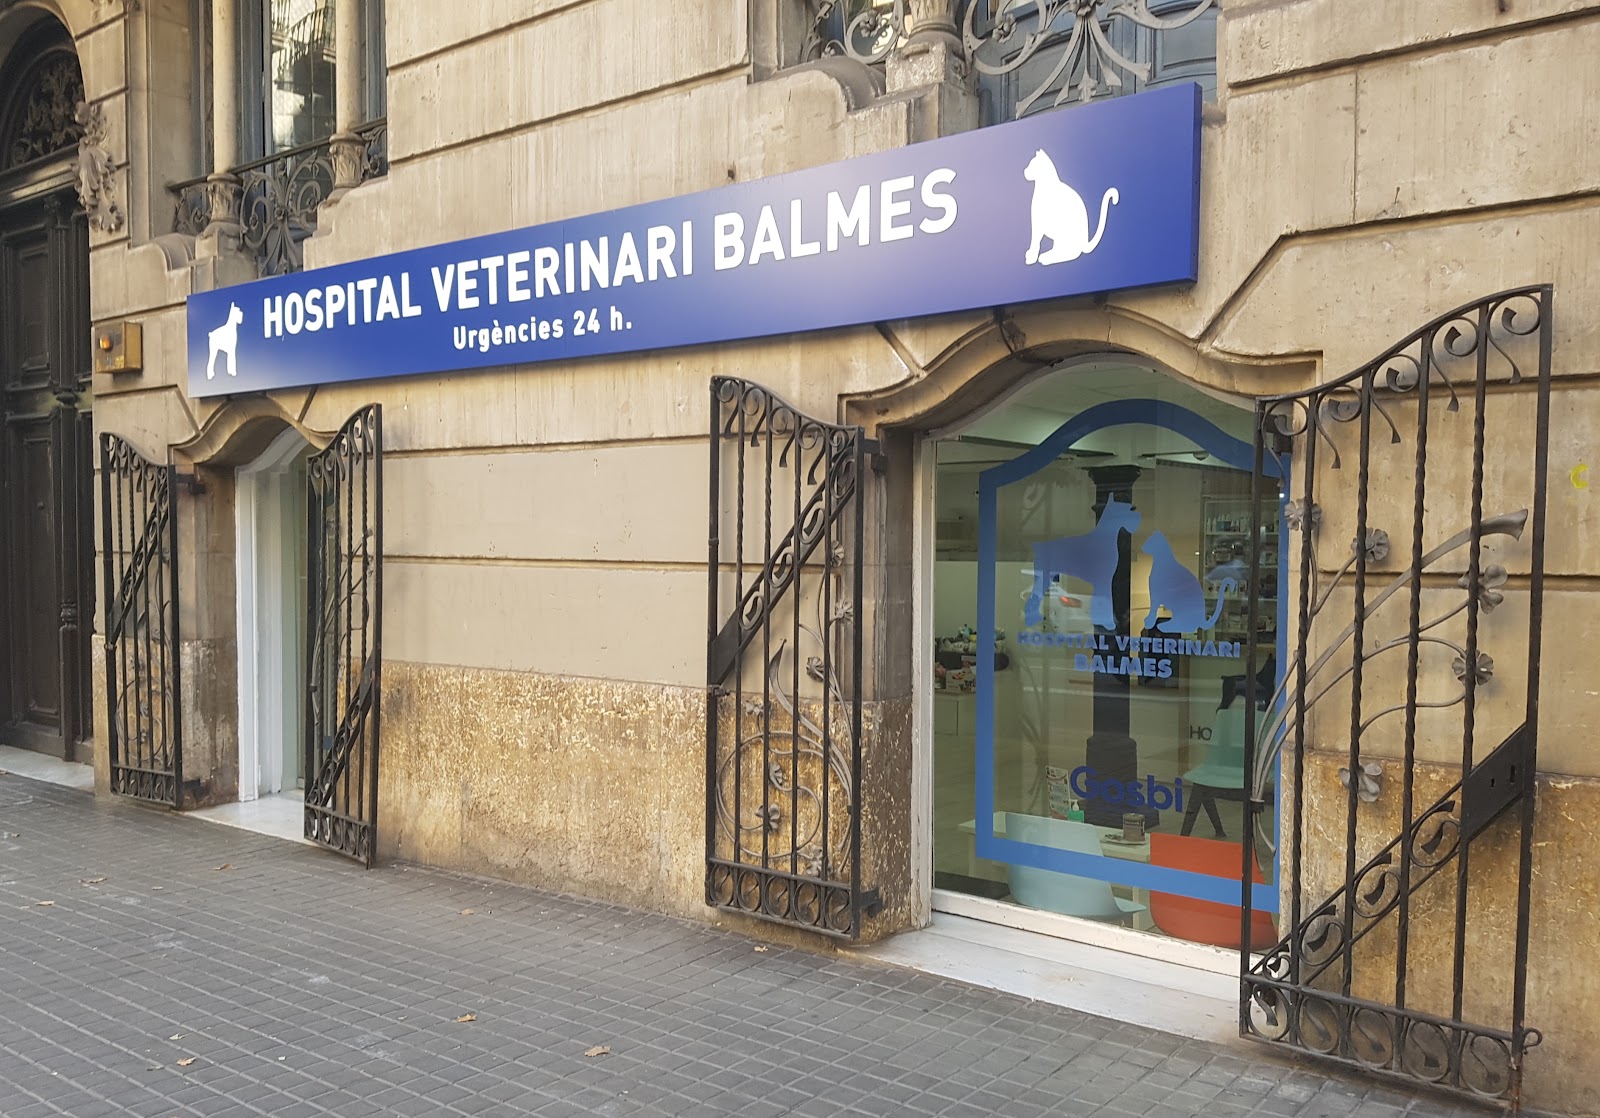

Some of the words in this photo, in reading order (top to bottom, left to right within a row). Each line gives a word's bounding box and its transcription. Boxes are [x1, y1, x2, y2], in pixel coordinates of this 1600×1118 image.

[263, 271, 422, 339] HOSPITAL
[430, 220, 693, 313] VETERINARI
[713, 167, 959, 272] BALMES
[452, 318, 565, 354] Urgències
[572, 309, 601, 337] 24
[609, 304, 633, 332] h.
[1017, 631, 1110, 651] HOSPITAL
[1115, 635, 1241, 658] VETERINARI
[1073, 653, 1173, 679] BALMES
[1070, 765, 1183, 812] Gosbi
